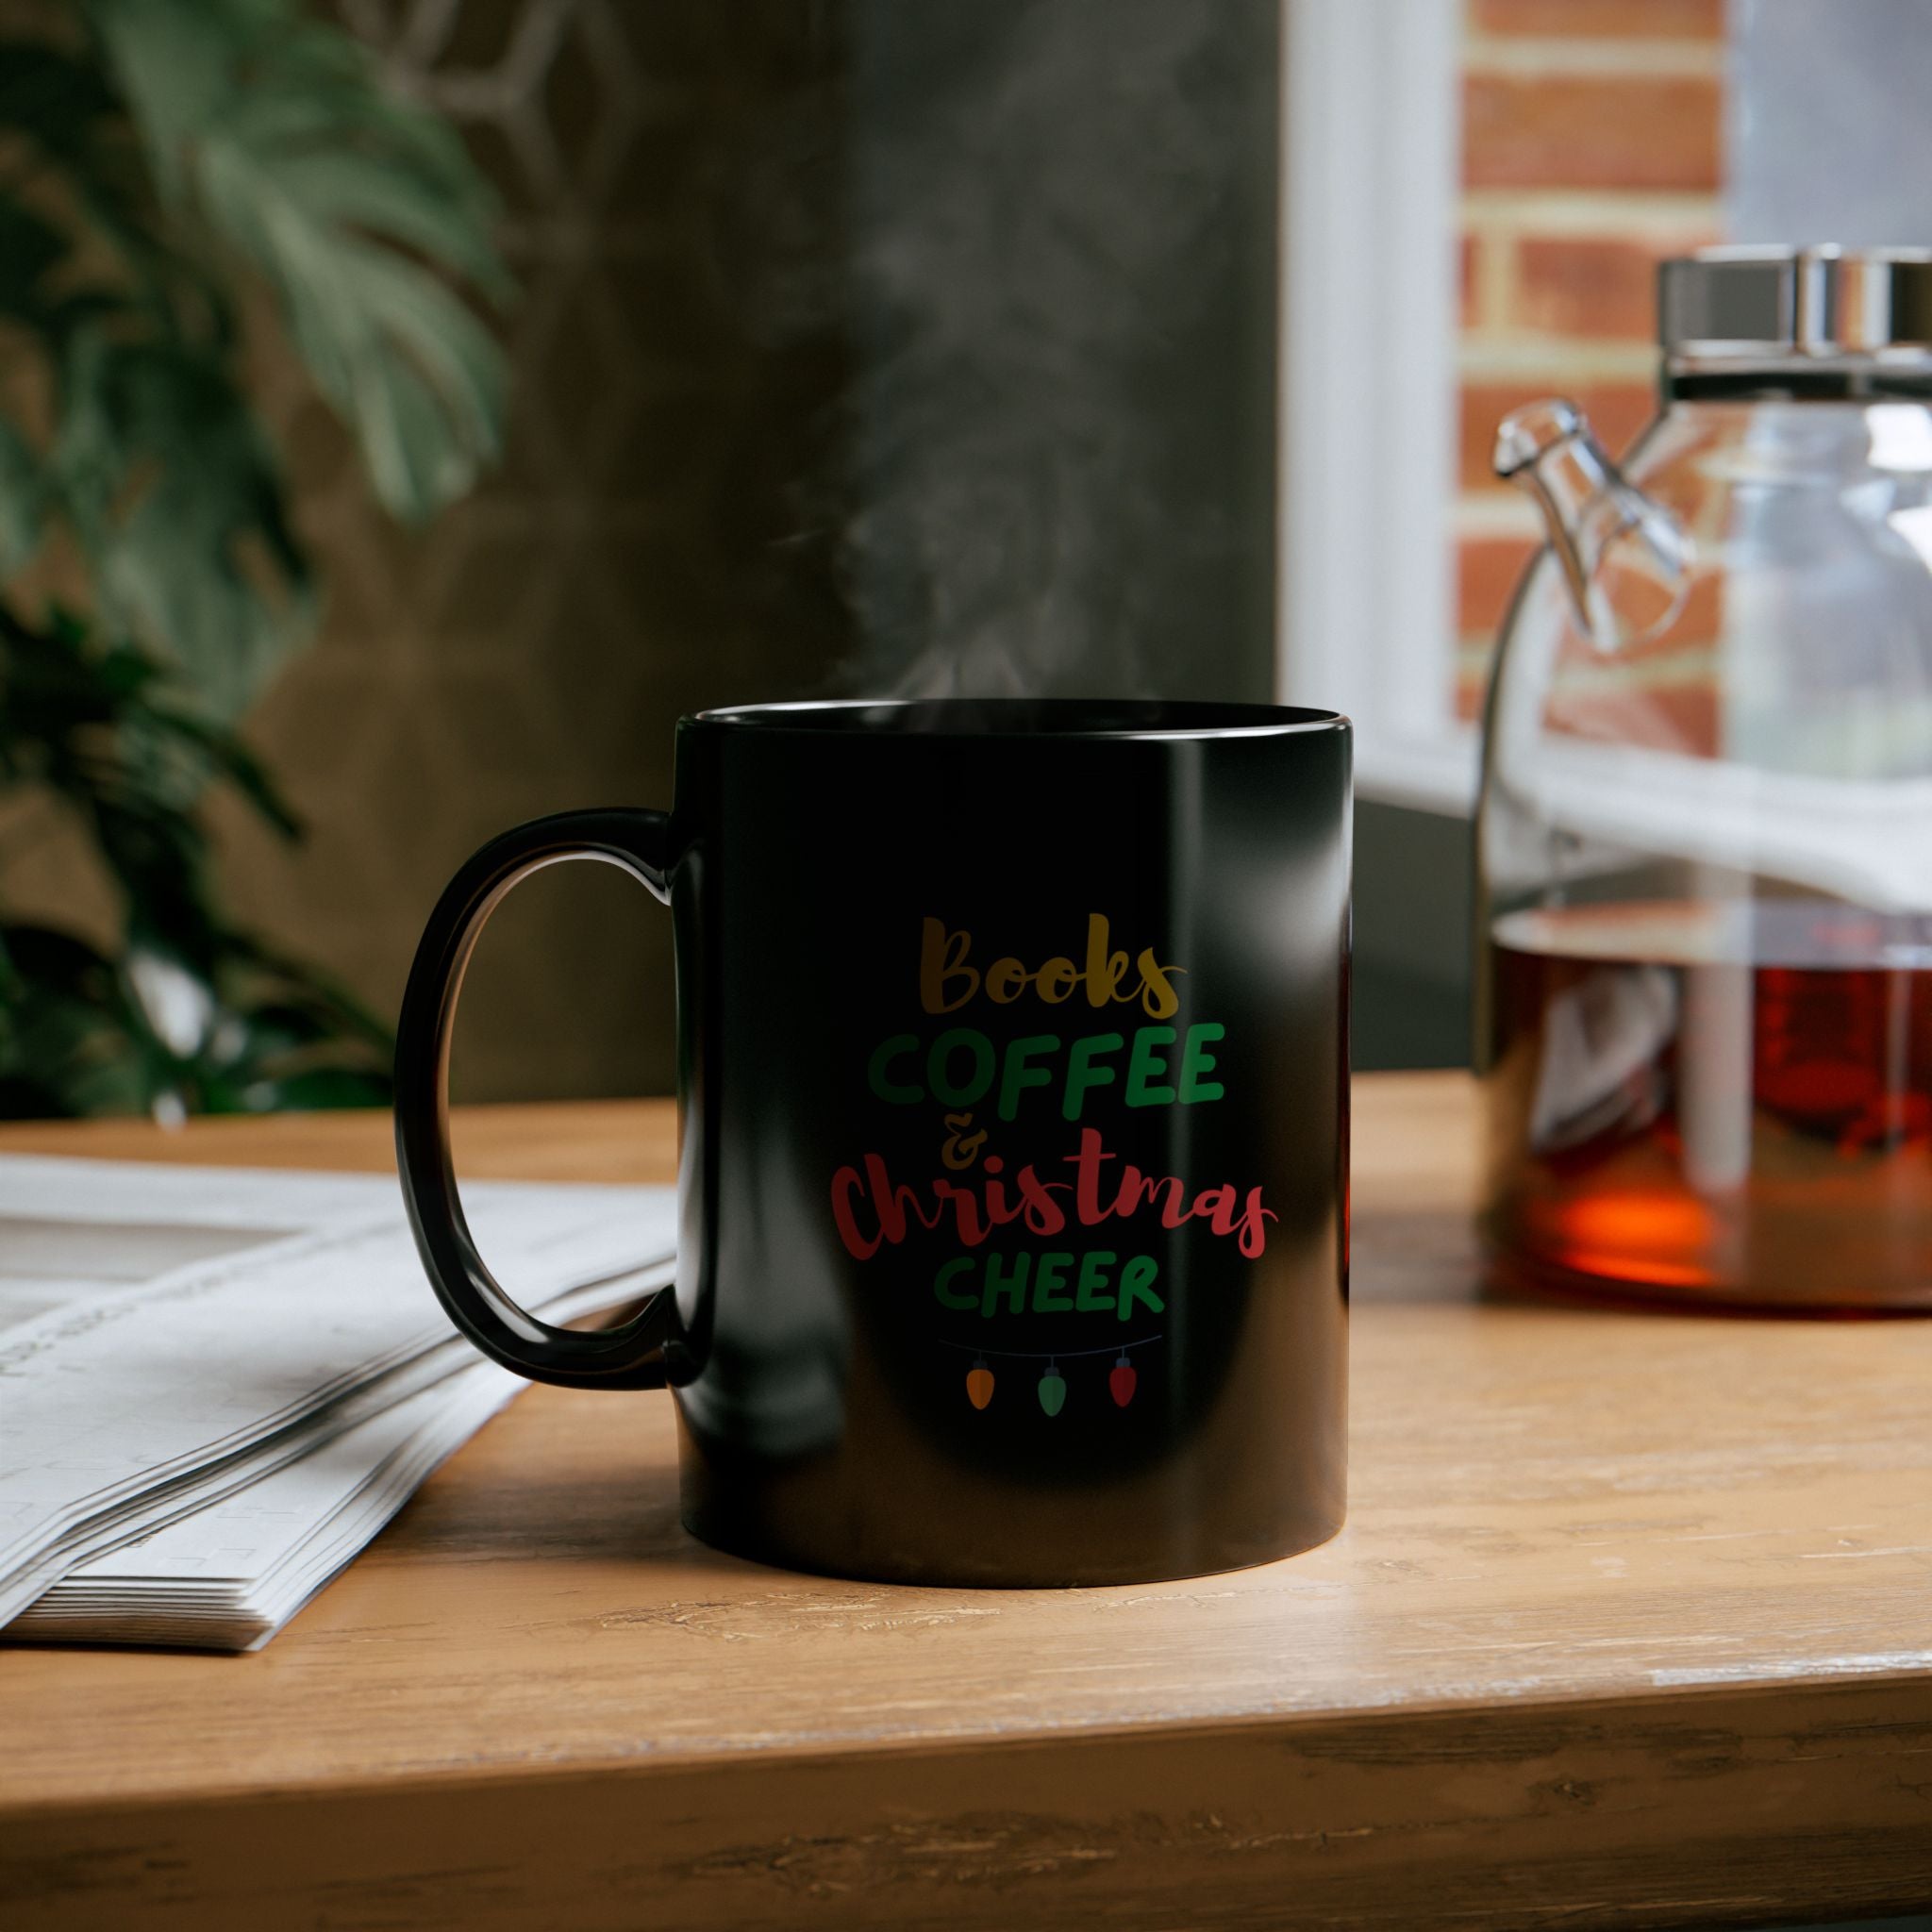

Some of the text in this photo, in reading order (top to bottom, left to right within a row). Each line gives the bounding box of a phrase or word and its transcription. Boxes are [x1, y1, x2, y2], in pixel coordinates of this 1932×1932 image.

[919, 913, 1189, 1020] Books
[867, 1022, 1227, 1123] COFFEE
[941, 1112, 989, 1171] &
[830, 1128, 1280, 1261] Christmas
[933, 1251, 1167, 1323] CHEER
